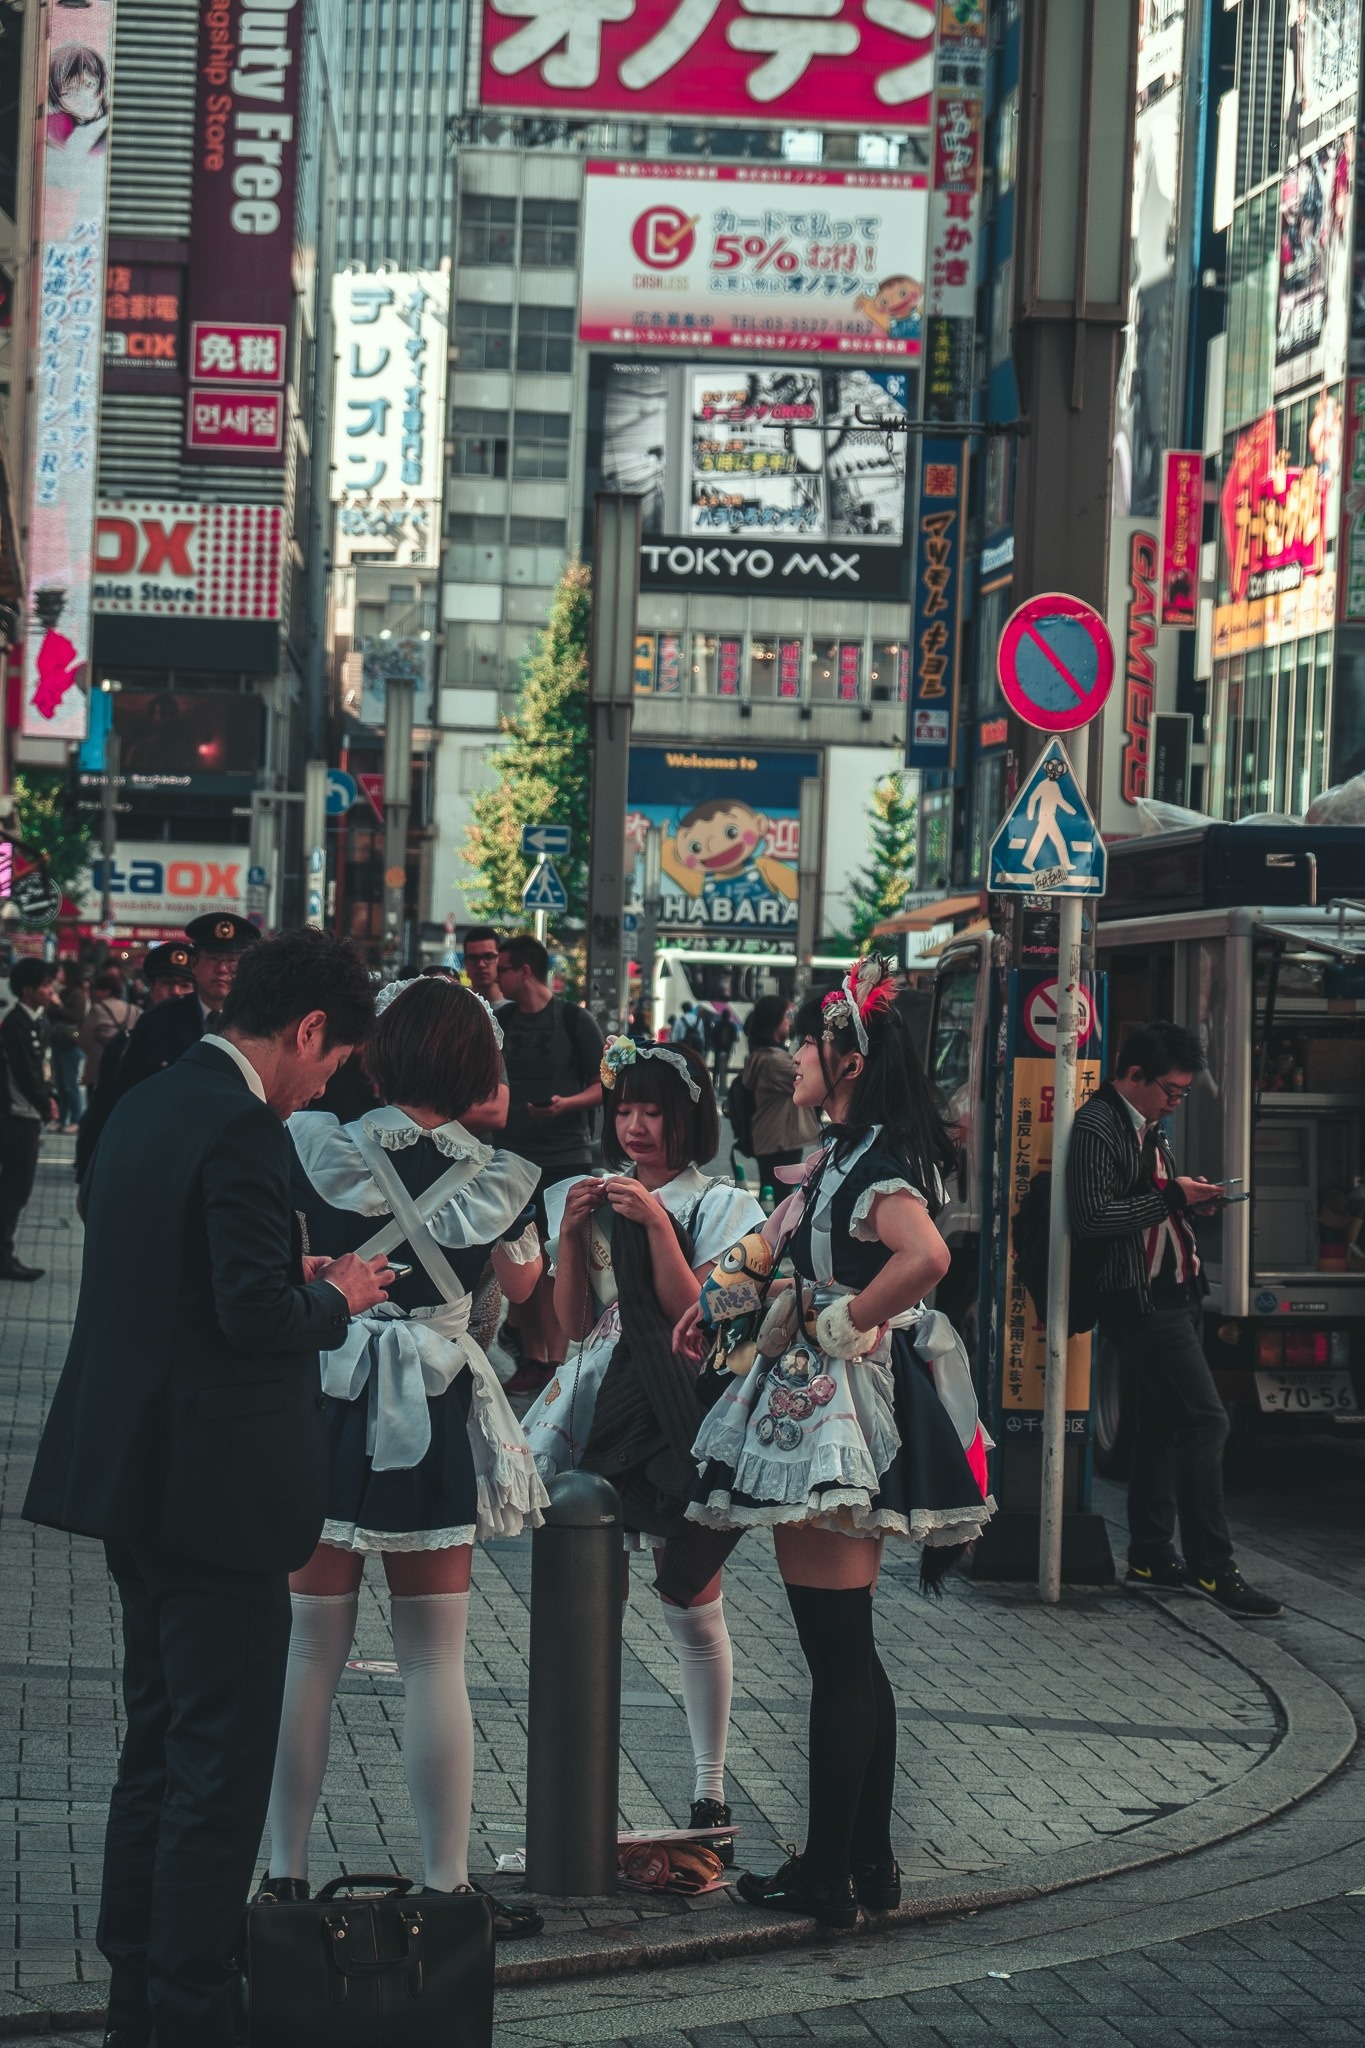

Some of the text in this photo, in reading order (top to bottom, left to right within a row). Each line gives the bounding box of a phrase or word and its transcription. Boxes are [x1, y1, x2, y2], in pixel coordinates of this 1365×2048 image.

[205, 94, 232, 172] Store
[231, 0, 298, 236] uty Free
[712, 208, 880, 241] カードで払って
[200, 333, 278, 373] 免税
[345, 287, 394, 490] テレオン
[194, 404, 277, 436] 면세점
[640, 545, 861, 582] TOKYO MX
[140, 580, 197, 601] Store
[920, 510, 957, 698] マツモトキヨシ
[1121, 528, 1160, 806] GAMERS
[665, 752, 758, 771] Welcome to
[1278, 1386, 1353, 1409] 70-56
